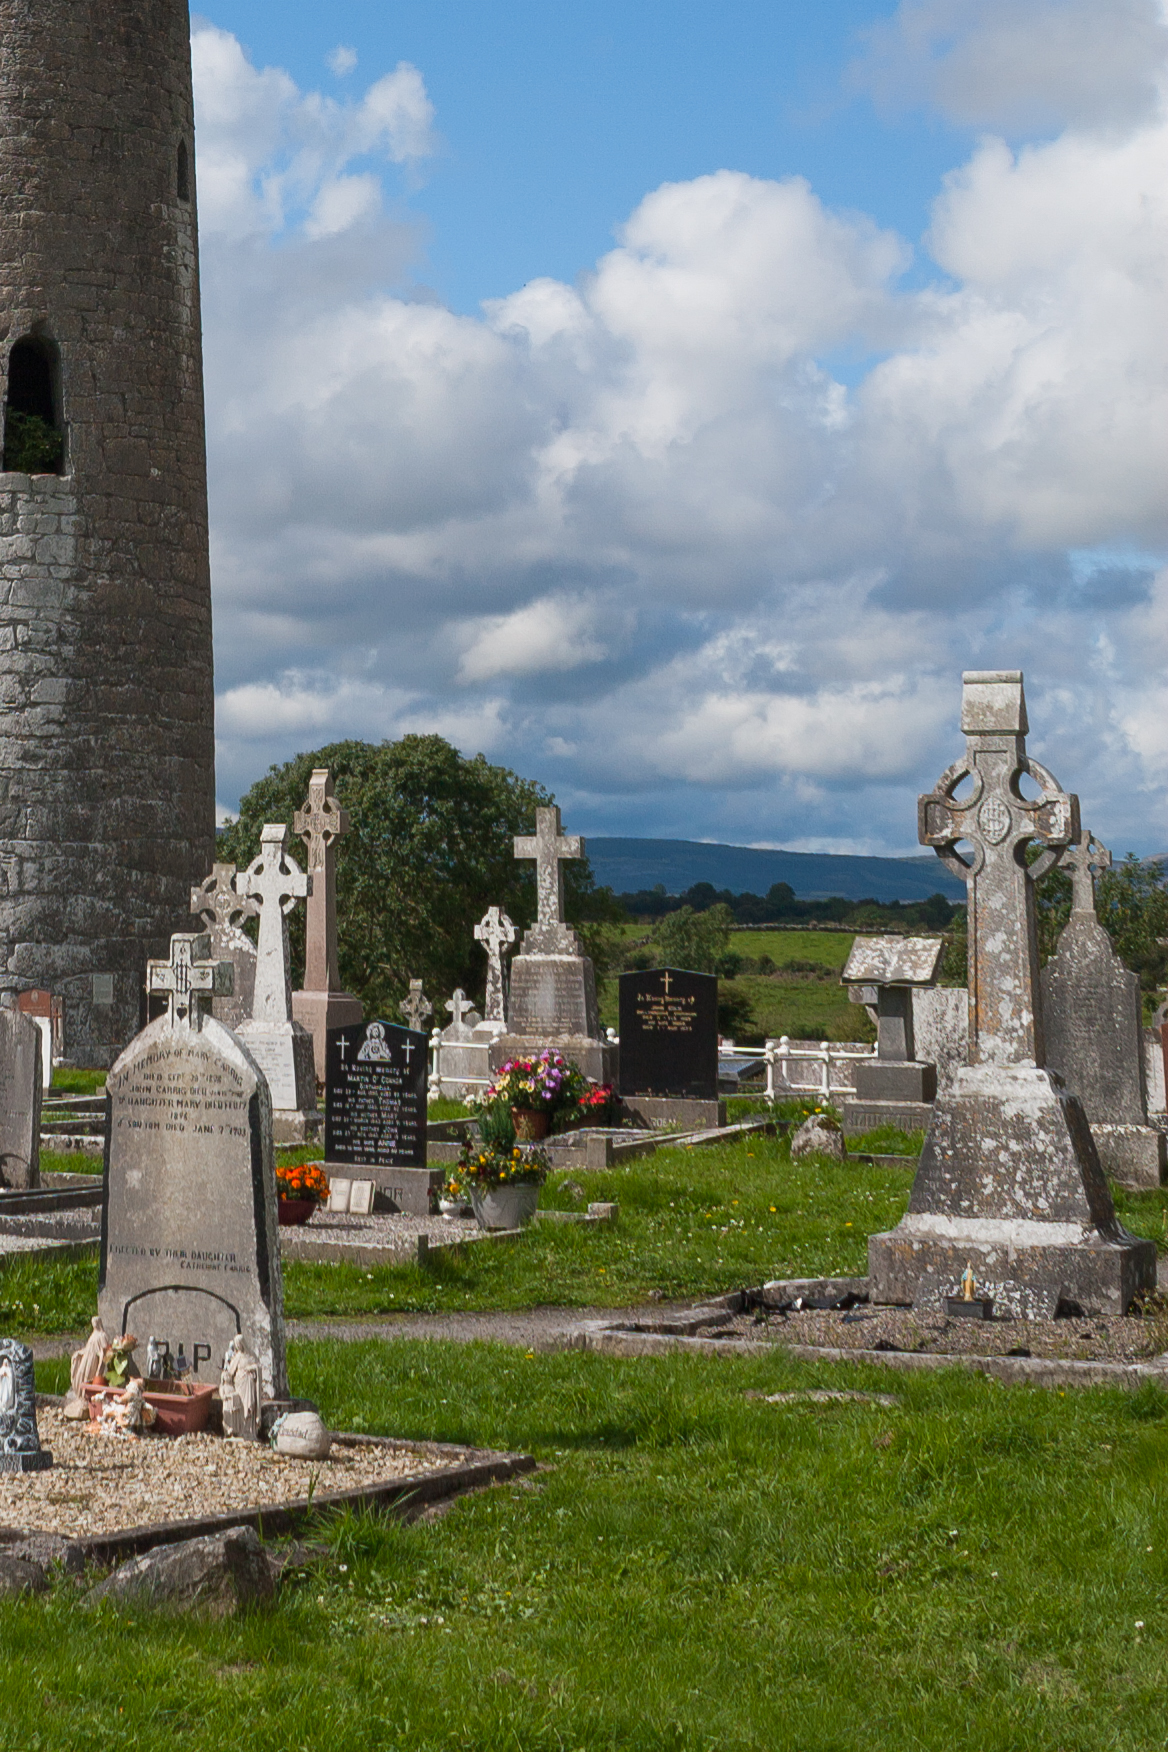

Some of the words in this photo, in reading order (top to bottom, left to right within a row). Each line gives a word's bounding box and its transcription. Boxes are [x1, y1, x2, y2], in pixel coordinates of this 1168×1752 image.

[133, 1050, 171, 1075] MEMORY
[173, 1049, 183, 1058] OF
[188, 1049, 210, 1063] MARY
[143, 1073, 163, 1081] DIED
[130, 1085, 152, 1094] JOHN
[155, 1086, 187, 1096] CARRIG
[127, 1097, 174, 1108] DAUGHTER
[176, 1099, 202, 1109] MARY
[165, 1123, 185, 1132] DIED
[191, 1250, 236, 1262] DAUGHTER
